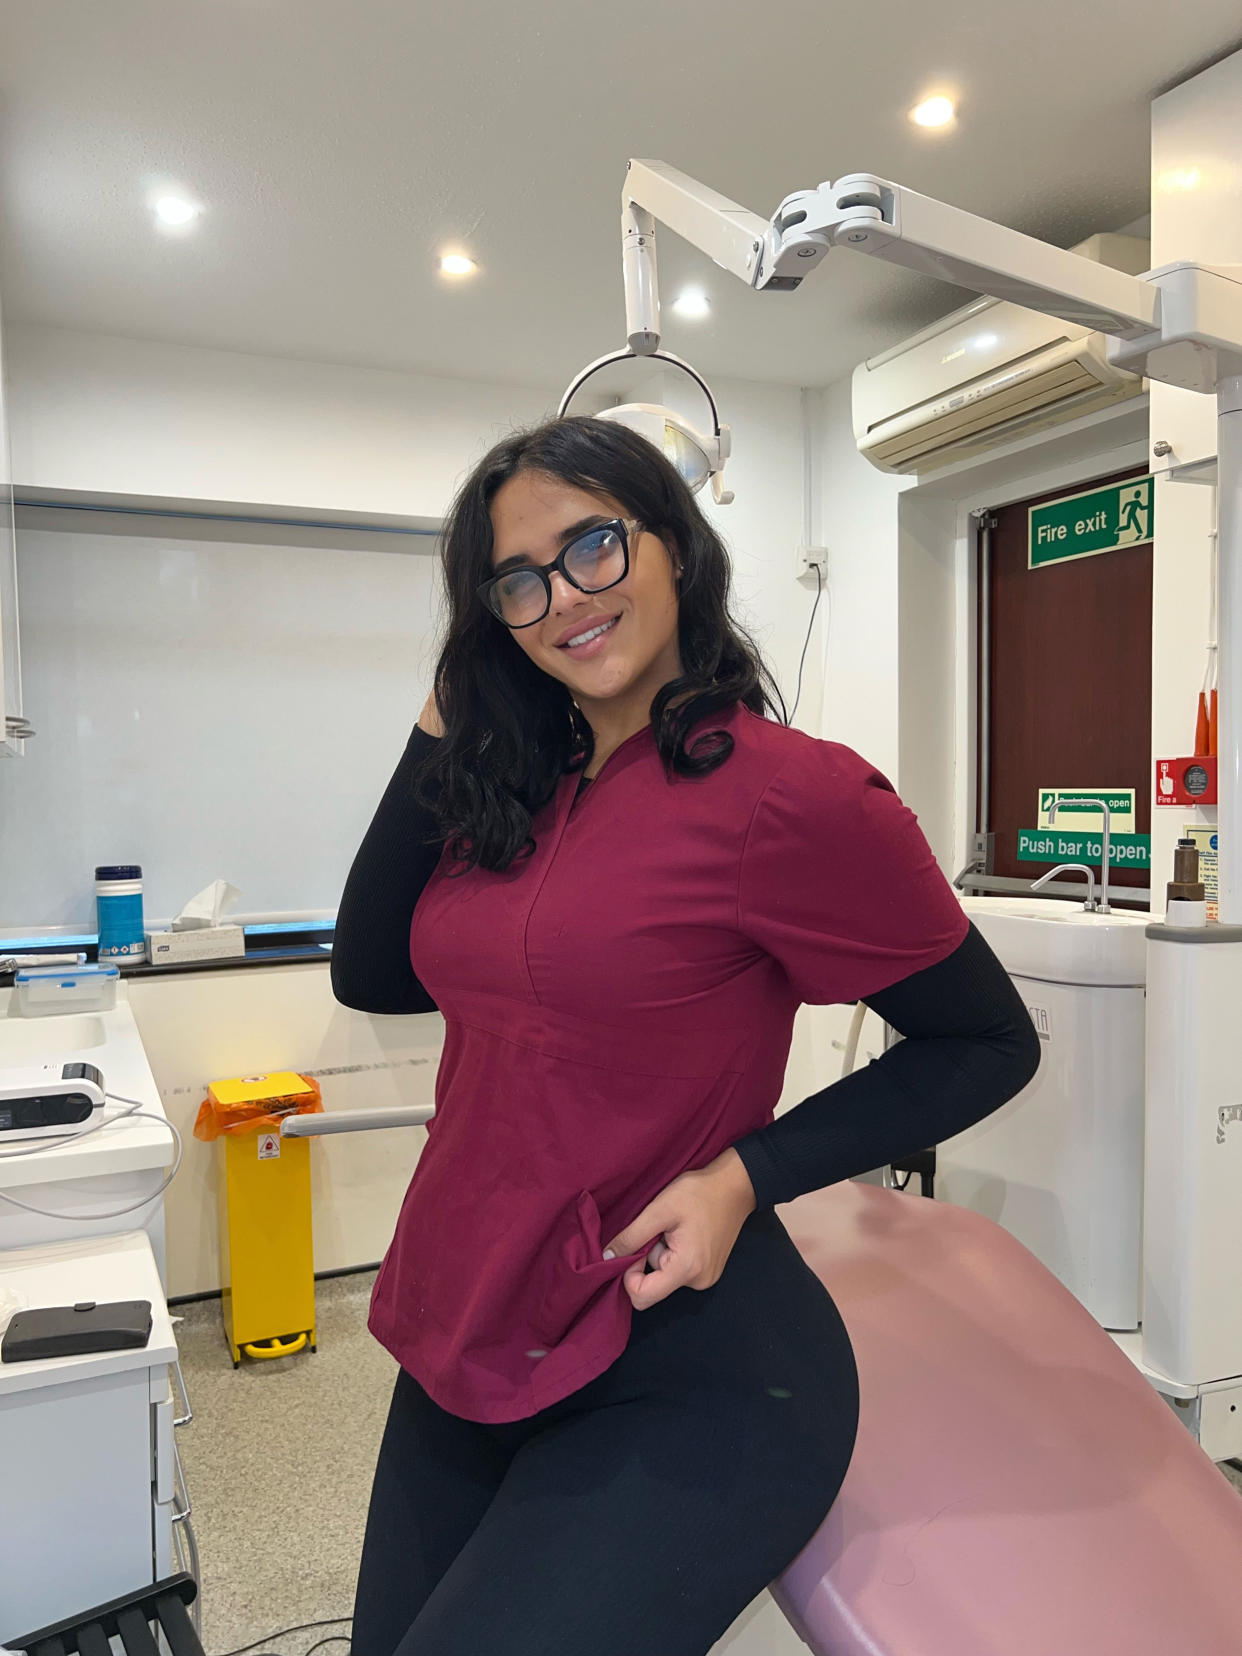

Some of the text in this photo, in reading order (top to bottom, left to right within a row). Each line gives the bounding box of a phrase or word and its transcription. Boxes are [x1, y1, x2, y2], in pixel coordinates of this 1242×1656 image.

[1038, 511, 1107, 545] Fire exit
[1108, 799, 1130, 809] open
[1158, 795, 1171, 804] Fire
[1019, 836, 1147, 863] Push bar to open
